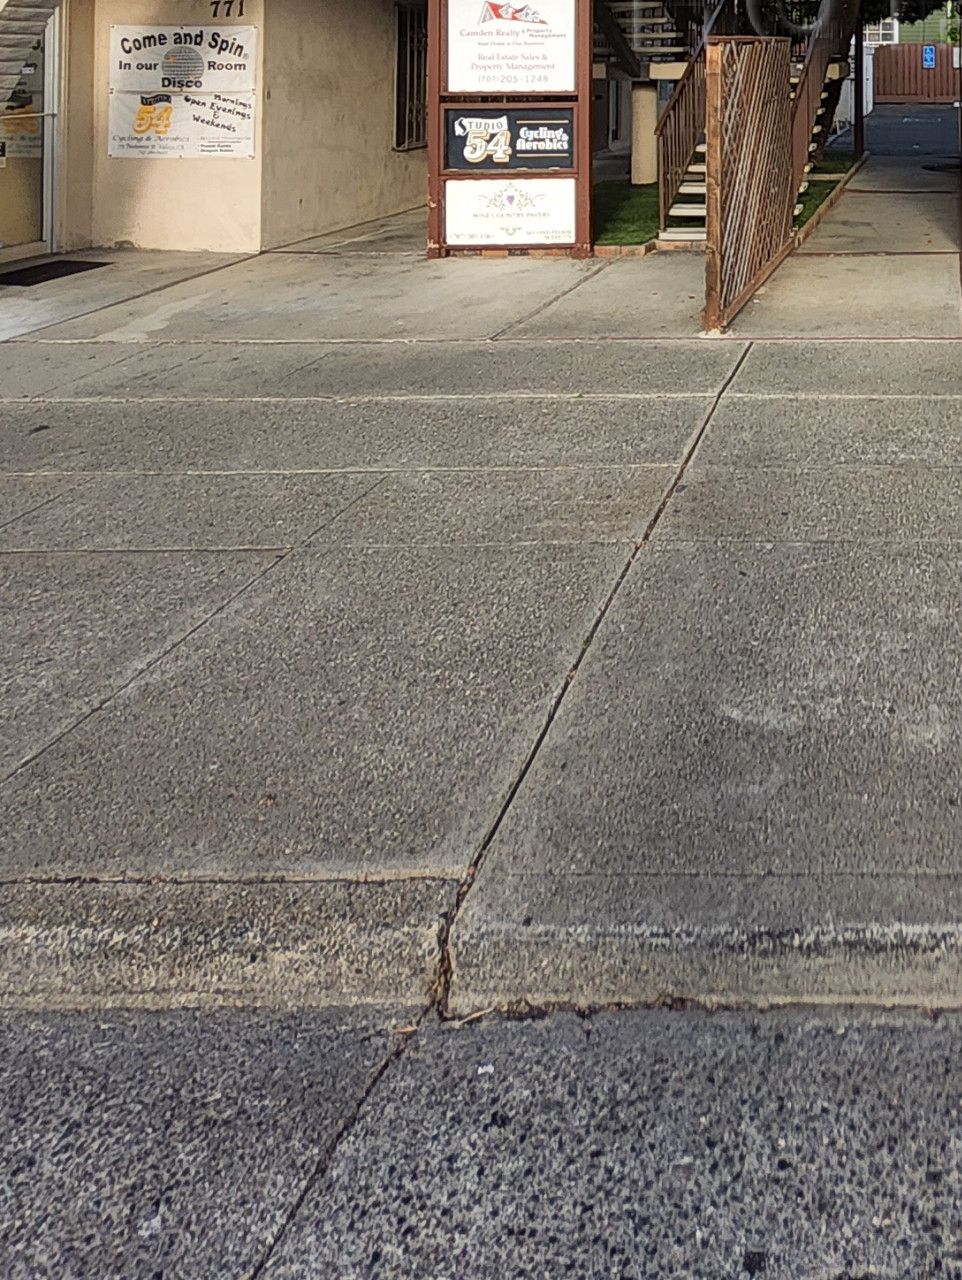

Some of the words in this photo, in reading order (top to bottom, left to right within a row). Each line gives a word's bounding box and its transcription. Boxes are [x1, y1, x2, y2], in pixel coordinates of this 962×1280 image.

[210, 0, 244, 18] 771
[459, 29, 493, 37] Camden
[495, 28, 520, 39] Realty
[121, 32, 167, 54] Come
[173, 30, 203, 45] and
[208, 32, 245, 57] Spin
[478, 53, 494, 61] Real
[496, 53, 518, 61] Estate
[520, 53, 540, 61] Sales
[118, 60, 131, 70] In
[136, 62, 159, 71] our
[207, 60, 246, 71] Room
[471, 63, 503, 72] Property
[506, 63, 555, 72] Management
[162, 77, 202, 88] Disco
[184, 95, 206, 107] Open
[210, 102, 251, 120] Evenings
[133, 104, 173, 135] 54
[192, 114, 236, 132] Weekends
[519, 127, 564, 140] Cycling
[463, 130, 512, 162] 54
[516, 138, 569, 150] Aerobics
